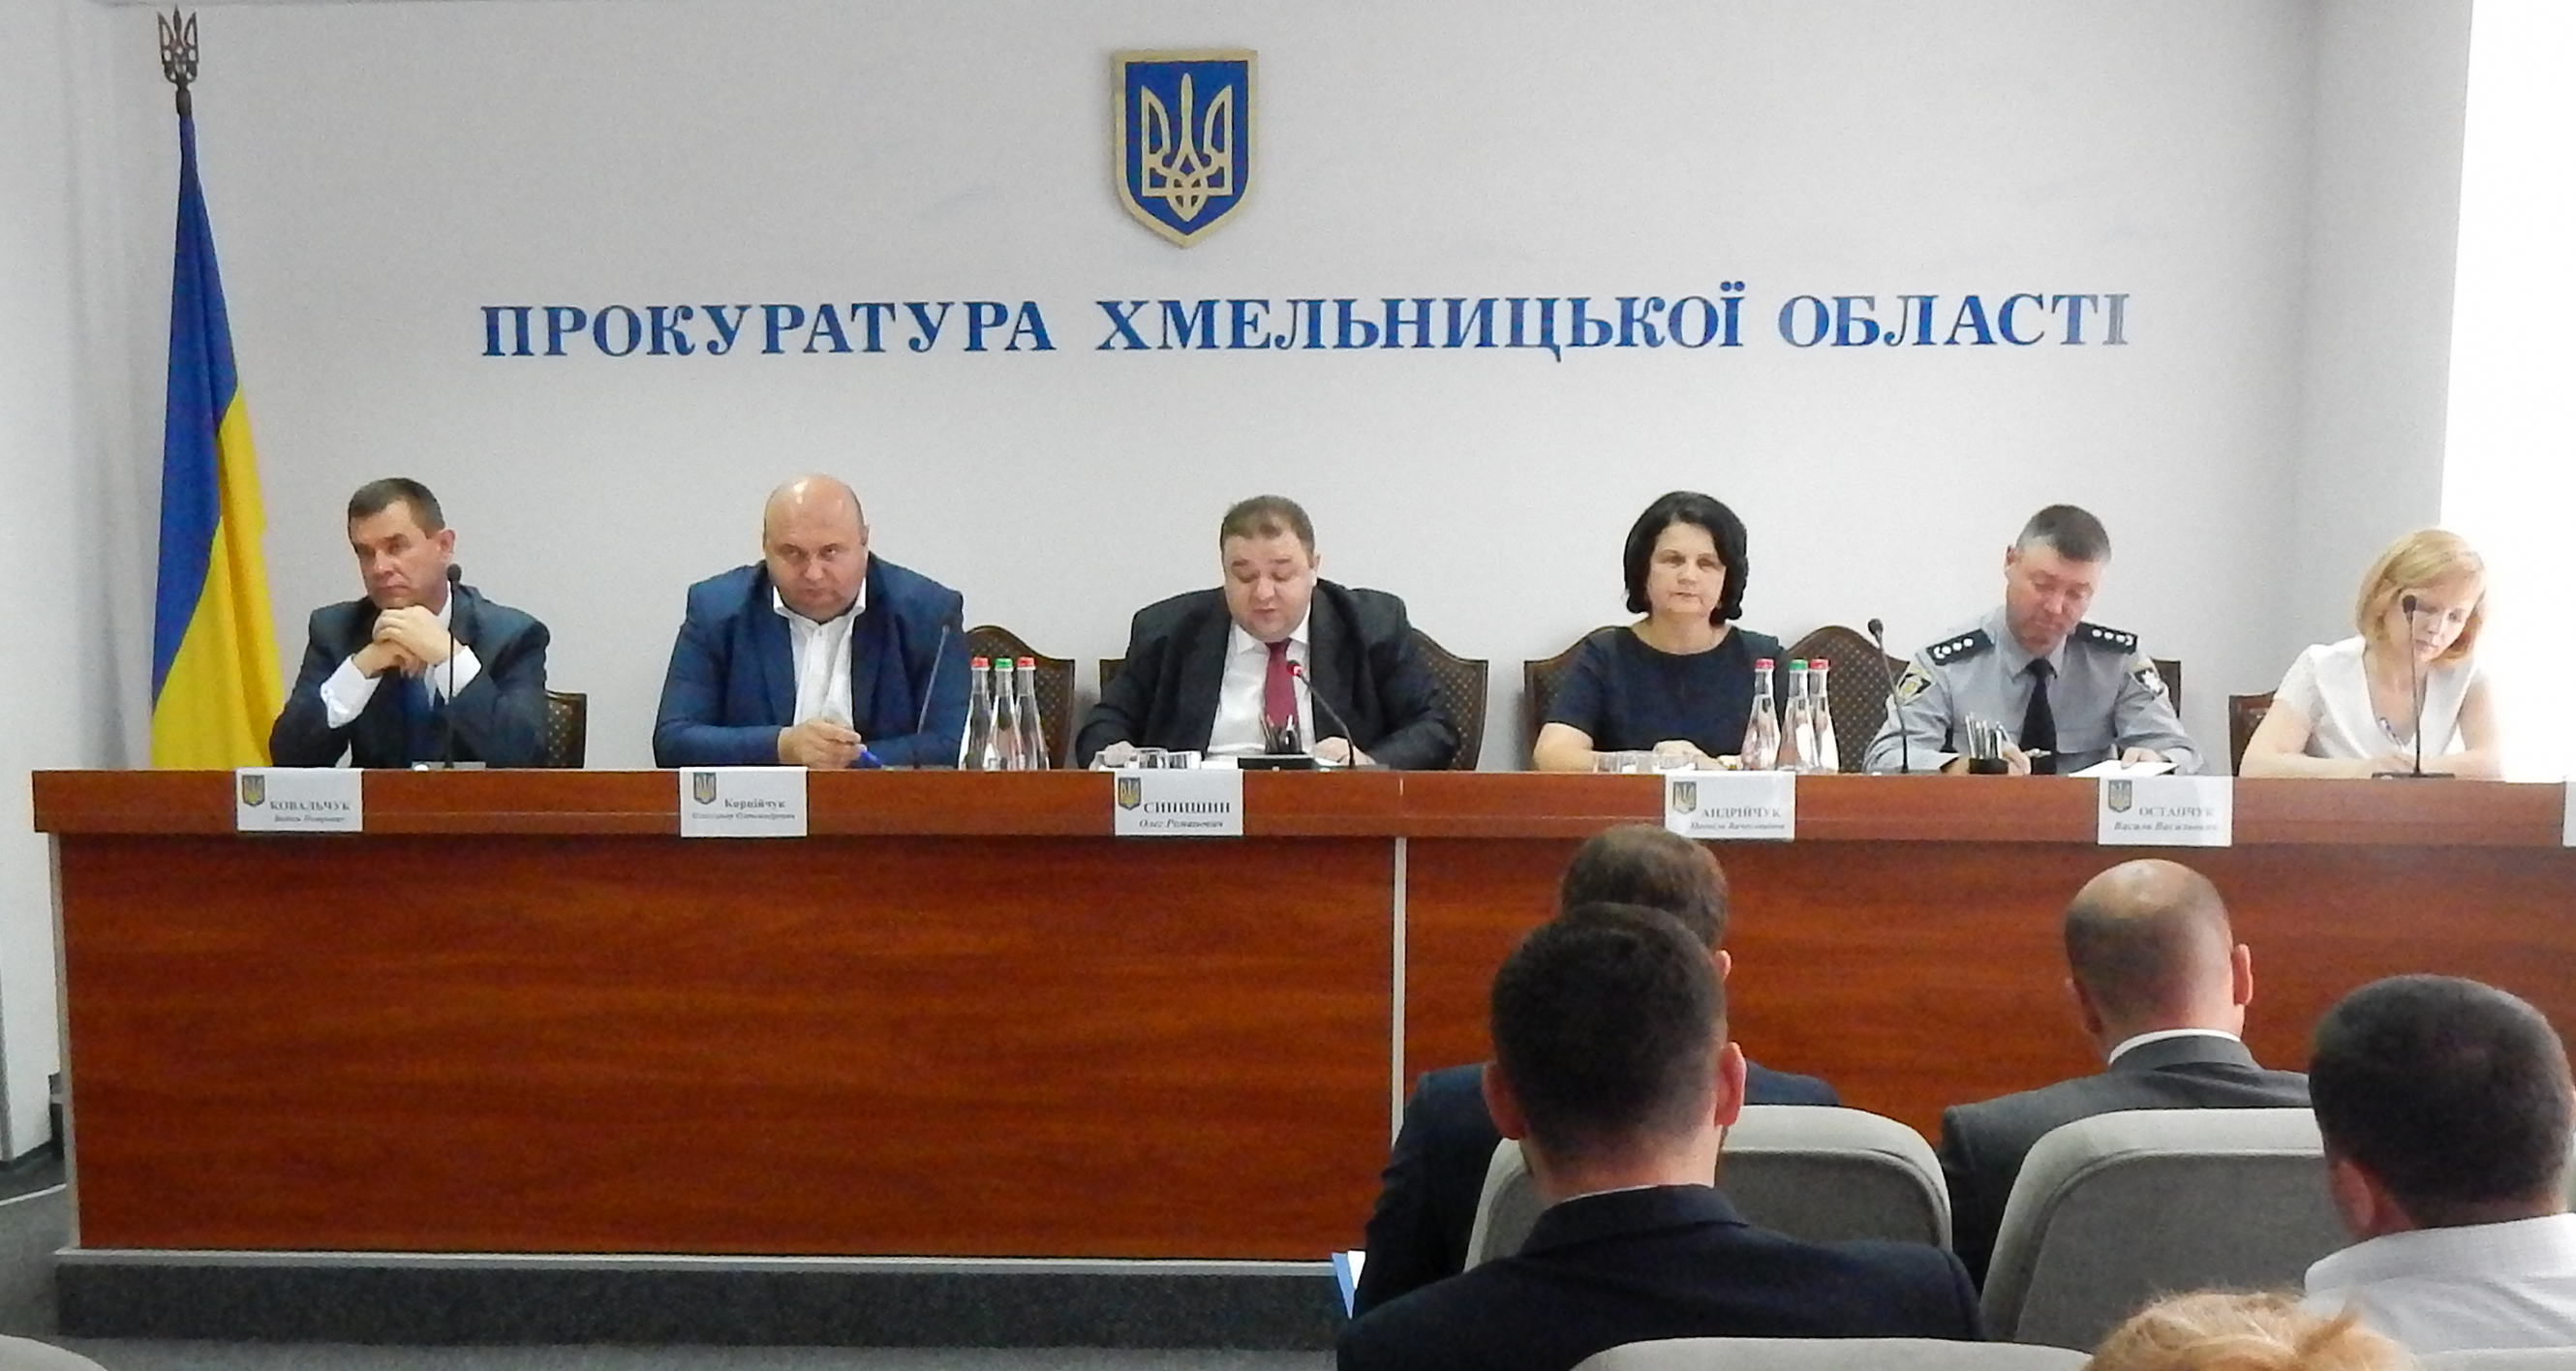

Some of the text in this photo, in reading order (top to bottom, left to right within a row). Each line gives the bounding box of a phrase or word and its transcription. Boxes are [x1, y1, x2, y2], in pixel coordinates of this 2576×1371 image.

[480, 281, 2131, 362] ПРОКУРАТУРА ХМЕЛЬНИЦЬКОЇ ОБЛАСТІ
[269, 800, 351, 811] КОВАЛЬЧУК
